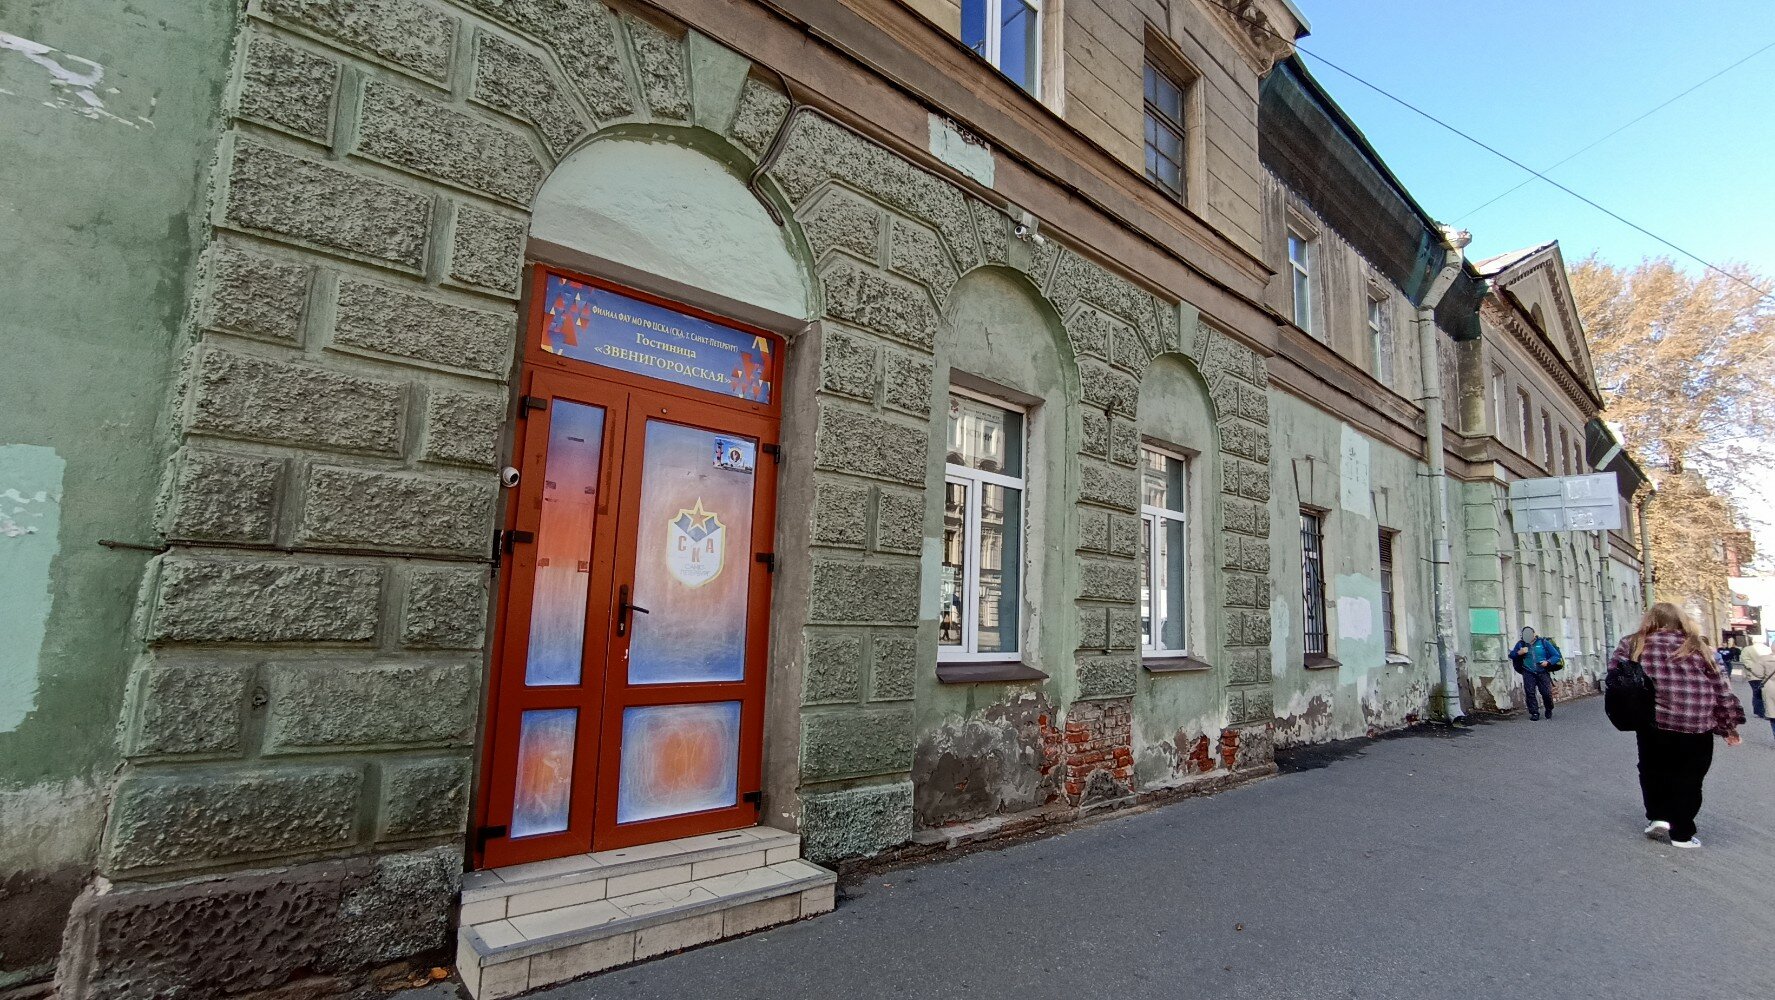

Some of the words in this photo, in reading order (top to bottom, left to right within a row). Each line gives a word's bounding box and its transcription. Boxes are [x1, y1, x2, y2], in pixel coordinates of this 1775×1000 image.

[592, 305, 617, 319] ФИЛИАЛ
[618, 313, 631, 322] ФАУ
[632, 317, 642, 326] МО
[643, 319, 652, 328] РФ
[652, 322, 669, 334] ЦСКА
[636, 333, 697, 359] Гостиница
[594, 344, 732, 384] «ЗВЕНИГОРОДСКАЯ»
